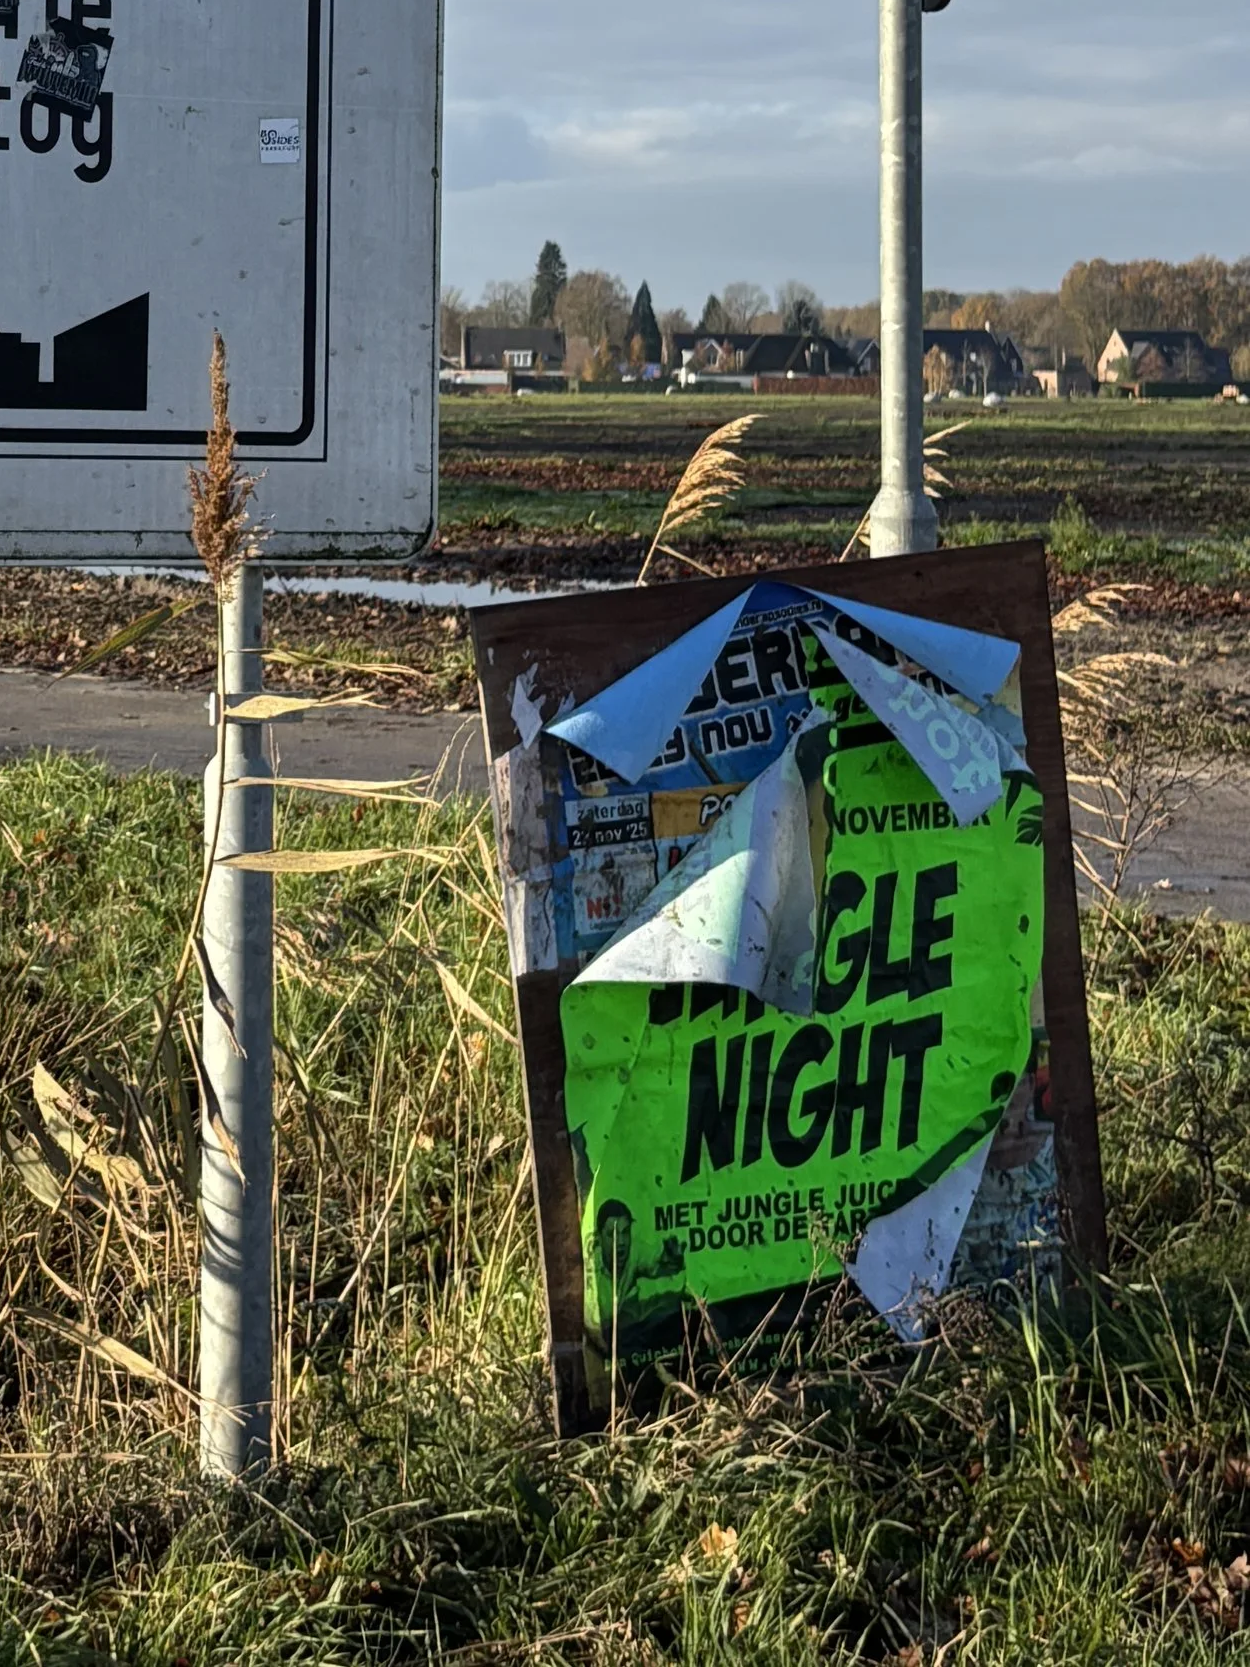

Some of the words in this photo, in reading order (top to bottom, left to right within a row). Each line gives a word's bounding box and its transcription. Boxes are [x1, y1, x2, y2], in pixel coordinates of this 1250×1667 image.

[680, 1012, 943, 1184] NIGHT
[654, 1200, 708, 1232] MET
[717, 1187, 825, 1223] JUNGLE
[834, 1178, 903, 1210] JUIC
[689, 1221, 766, 1253] DOOR
[774, 1215, 809, 1243] DE
